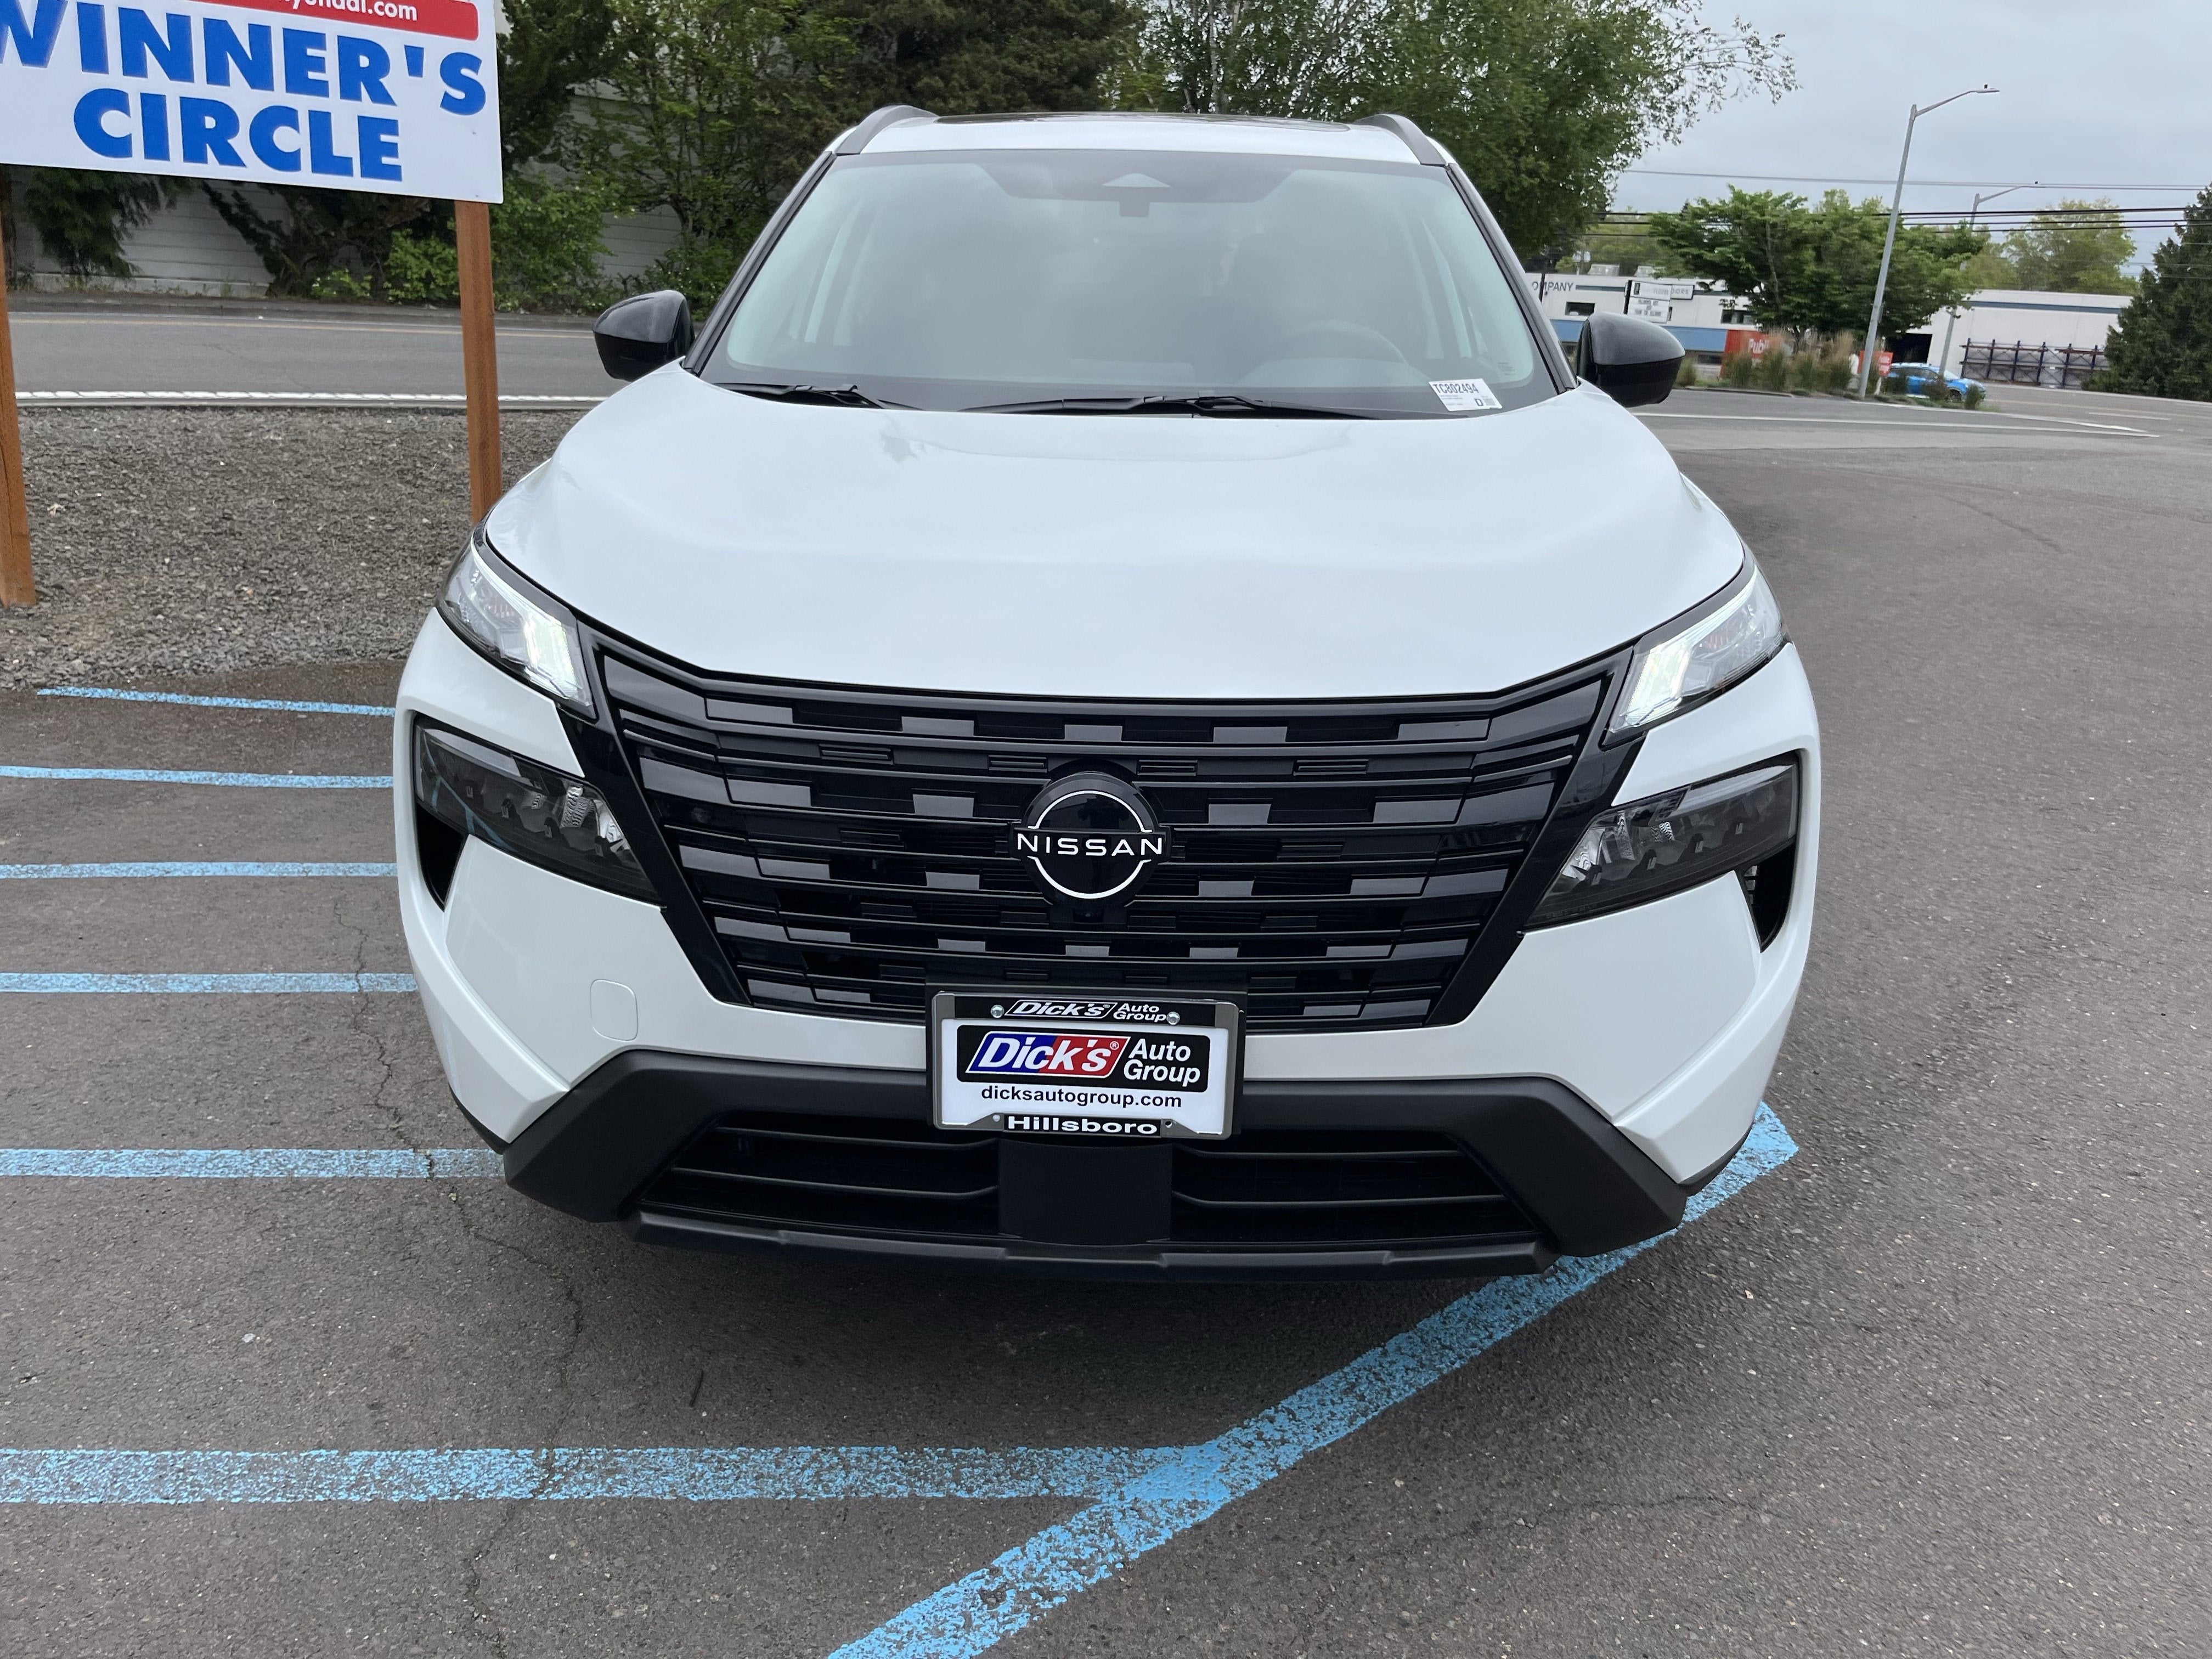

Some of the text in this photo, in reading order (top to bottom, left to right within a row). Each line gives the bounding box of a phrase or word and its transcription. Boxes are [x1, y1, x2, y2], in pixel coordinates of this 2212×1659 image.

[0, 0, 487, 116] WINNER'S
[74, 88, 403, 182] CIRCLE
[1433, 383, 1479, 393] TC802494
[1018, 833, 1162, 856] NISSAN
[1113, 1011, 1167, 1023] Group
[1118, 1003, 1159, 1013] Auto
[1128, 1039, 1191, 1062] Auto
[1124, 1060, 1201, 1087] Group
[981, 1086, 1182, 1108] dicksautogroup.com
[1008, 1116, 1158, 1135] Hillsboro
